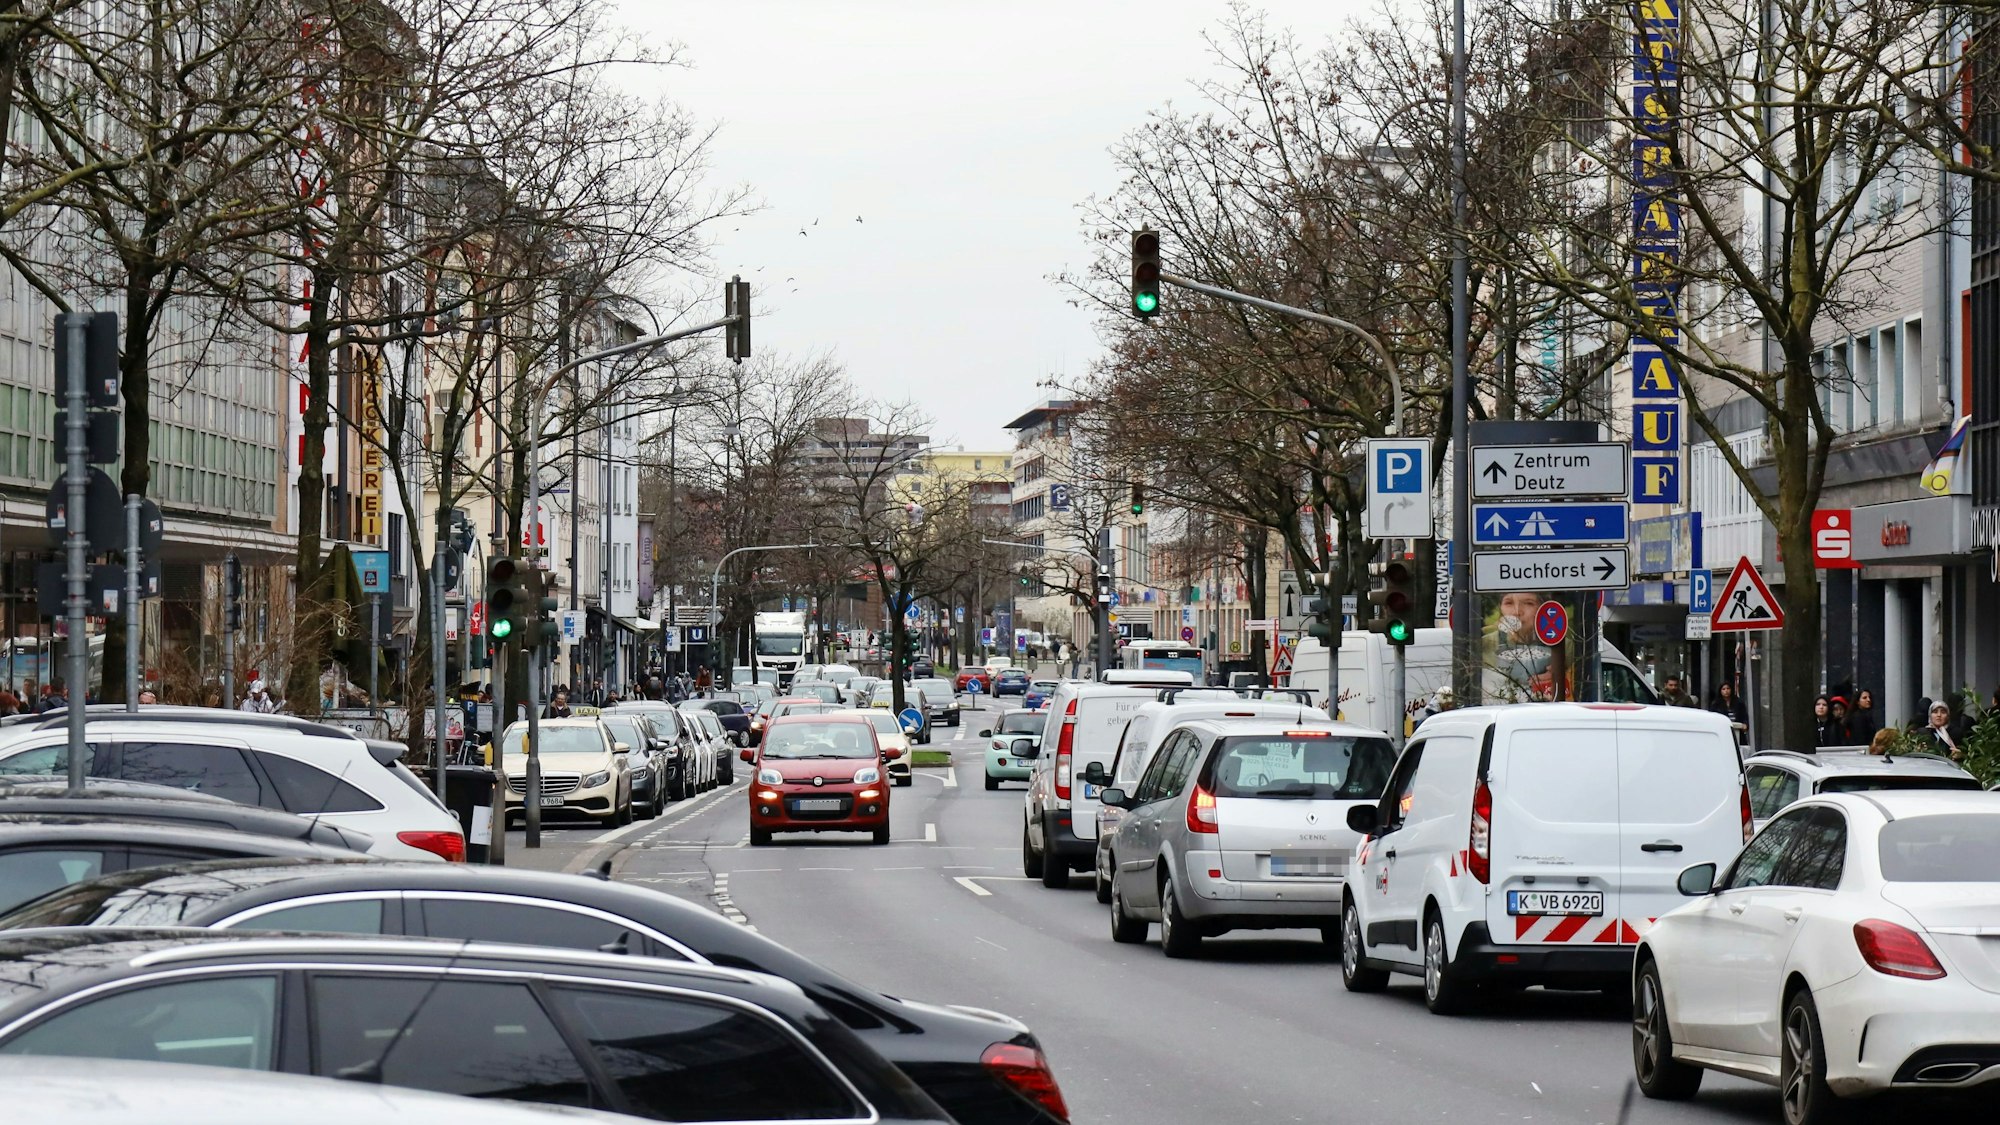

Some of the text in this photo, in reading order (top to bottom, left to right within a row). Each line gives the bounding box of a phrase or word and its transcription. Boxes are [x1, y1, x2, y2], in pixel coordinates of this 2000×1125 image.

[1514, 453, 1590, 469] Zentrum
[1386, 452, 1412, 489] P
[1515, 475, 1565, 491] Deutz
[1971, 508, 2000, 583] mang
[1499, 562, 1586, 581] Buchforst
[1695, 575, 1707, 608] P
[546, 797, 563, 805] 9684
[1519, 894, 1600, 910] K VB 6920
